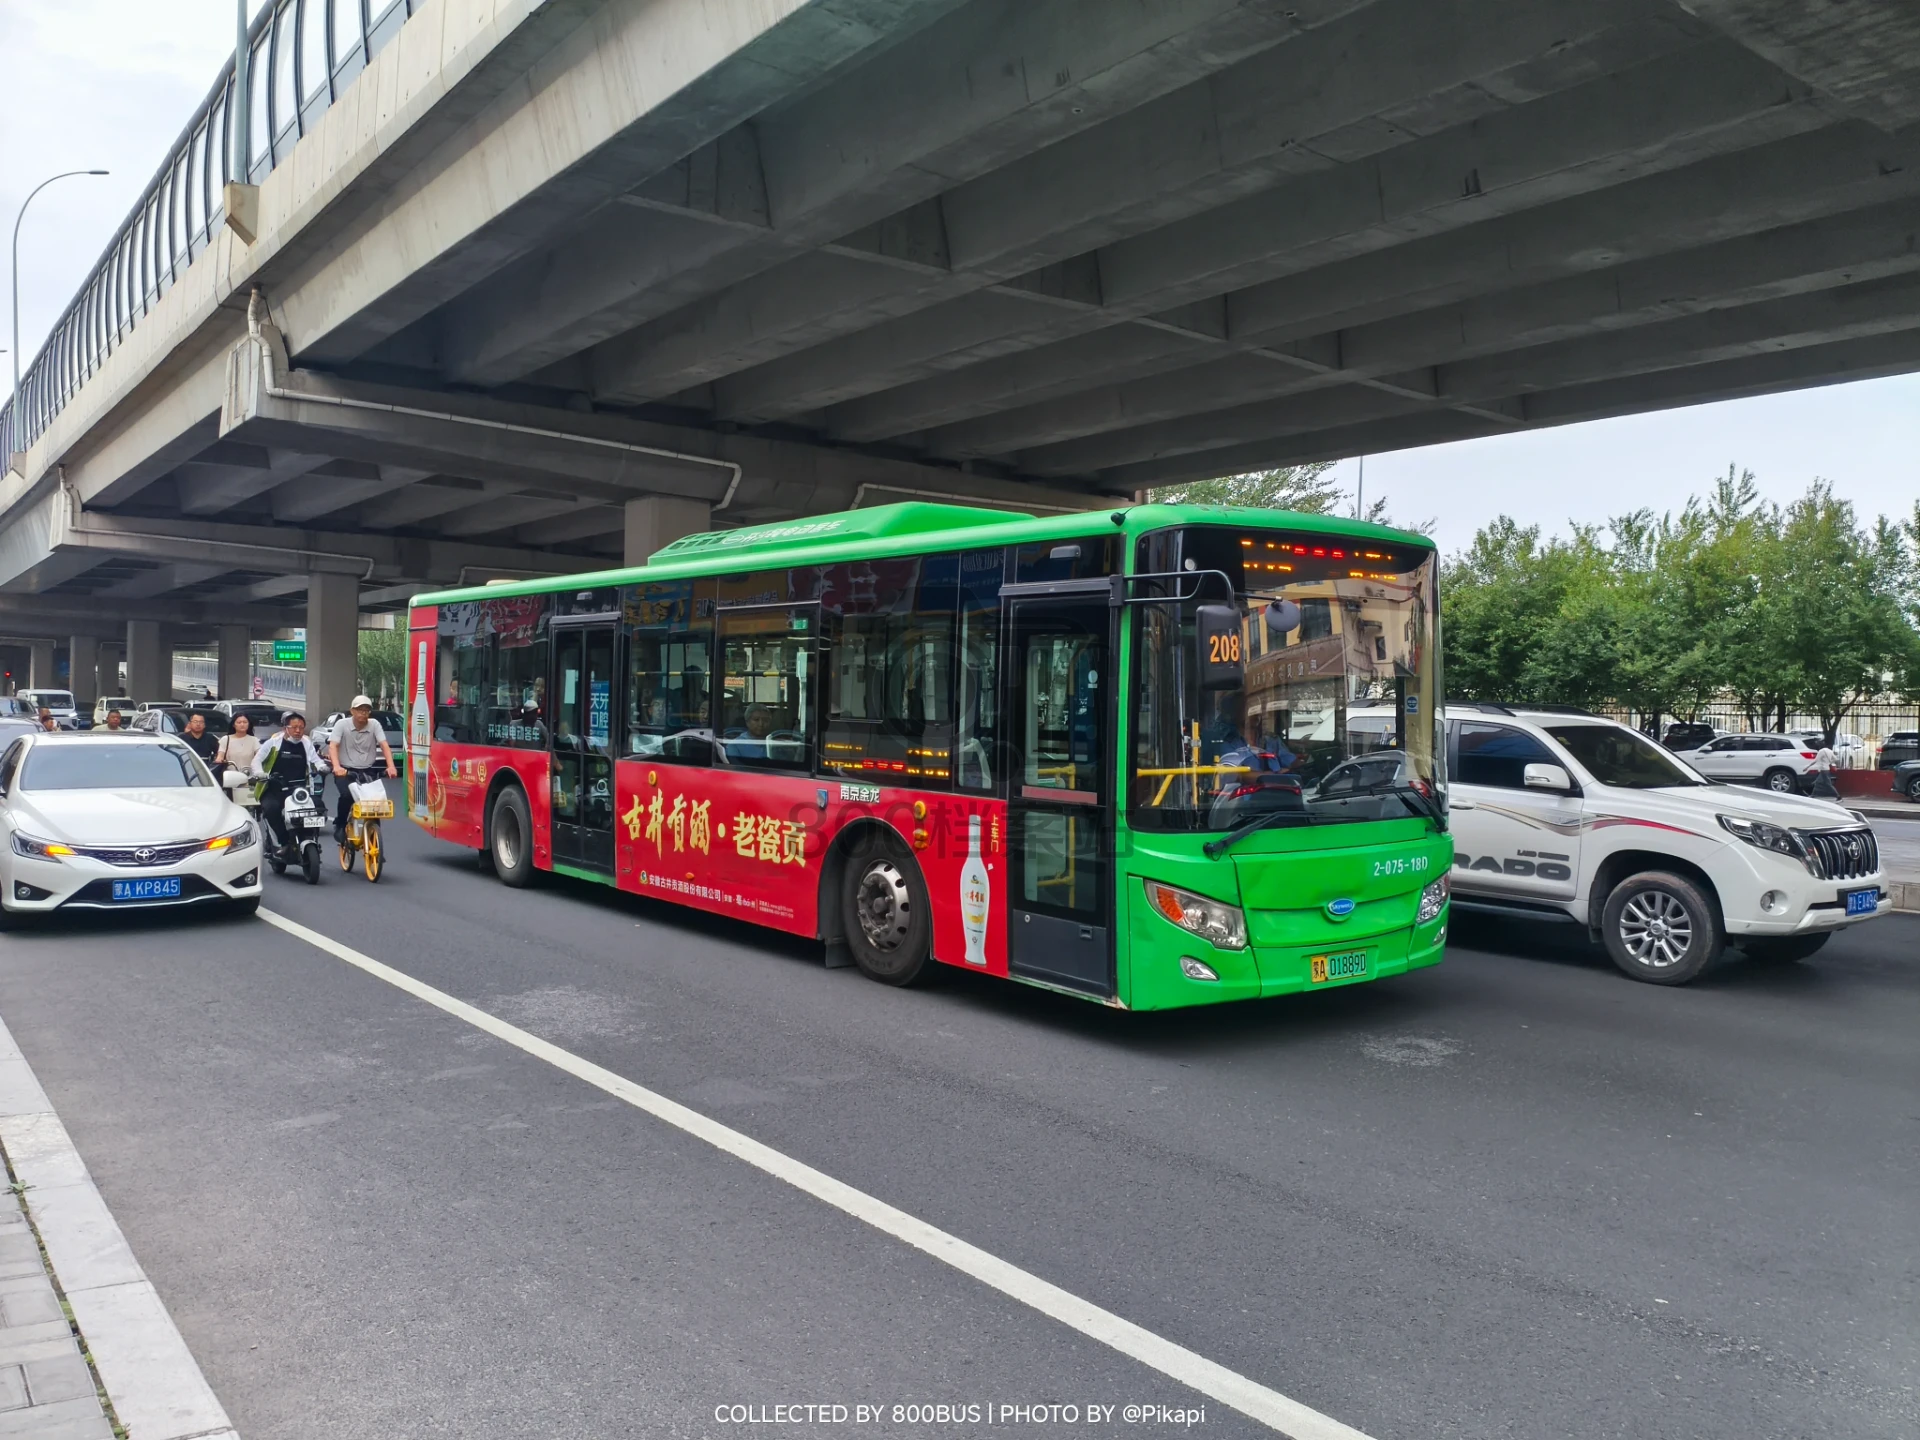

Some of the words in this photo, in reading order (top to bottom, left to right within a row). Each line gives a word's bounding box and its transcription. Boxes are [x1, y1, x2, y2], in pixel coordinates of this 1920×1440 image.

[1210, 635, 1239, 662] 208
[488, 723, 540, 741] 开沃纯电动客车
[840, 785, 880, 803] 南京金龙
[1454, 852, 1571, 881] RADO
[649, 874, 721, 902] 安徽古井贡酒股份有限公司
